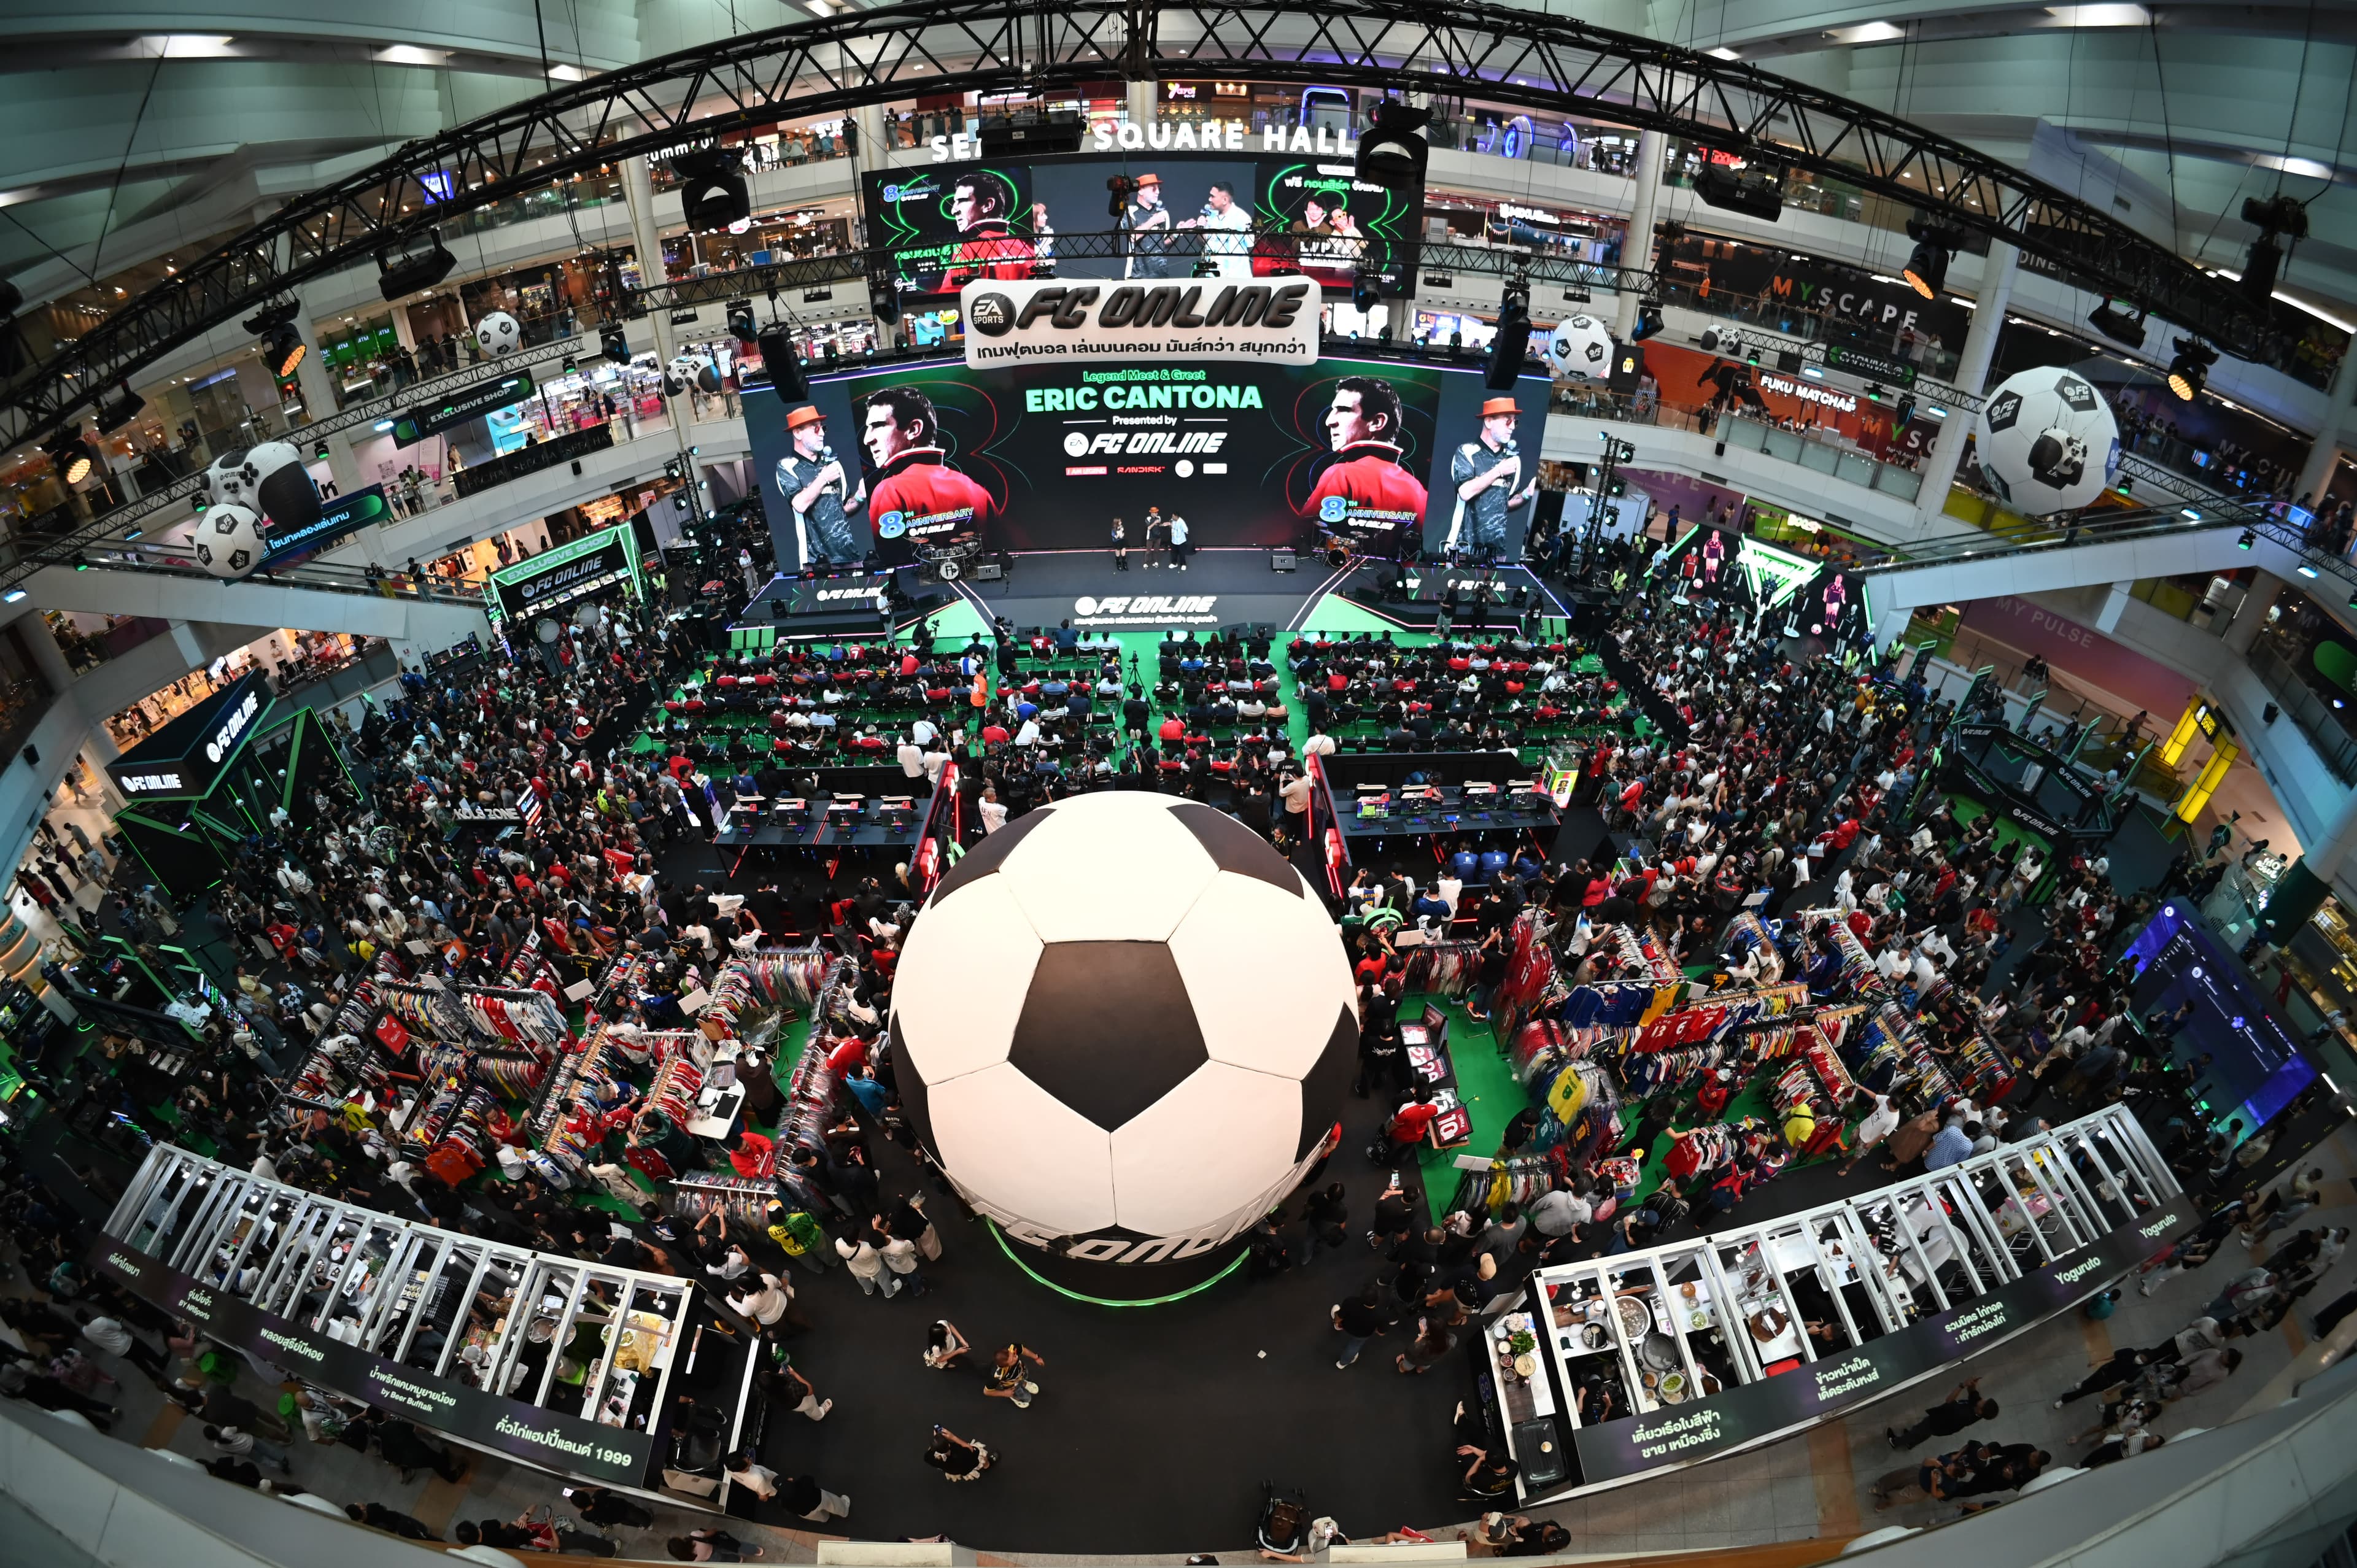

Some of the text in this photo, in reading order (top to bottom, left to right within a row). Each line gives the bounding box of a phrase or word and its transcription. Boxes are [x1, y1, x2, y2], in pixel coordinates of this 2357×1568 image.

[931, 122, 1355, 162] SE SQUARE HALL
[883, 185, 899, 202] 8
[973, 299, 1003, 316] EA
[1016, 284, 1309, 330] FC ONLINE
[973, 315, 1004, 325] SPORTS
[977, 337, 1306, 359] เกมฟุตบอล เล่นบนคอม มันส์กว่า สนุกกว่า
[1083, 370, 1206, 384] Legend Meet & Greet
[1026, 385, 1263, 412] ERIC CANTONA
[1760, 376, 1847, 411] FUKU MATCHA
[2075, 385, 2089, 395] FC
[430, 387, 511, 423] EXCLUSIVE SHOP
[2000, 399, 2018, 412] FC
[1113, 415, 1177, 426] Presented by
[1992, 411, 2011, 423] ONLINE
[1088, 432, 1228, 454] FC ONLINE
[906, 507, 974, 528] ANNIVERSARY
[1320, 496, 1347, 522] 8
[1346, 509, 1417, 520] ANNIVERSARY
[269, 511, 350, 550] โซนทดลองเล่นเกม
[878, 511, 906, 538] 8
[507, 535, 608, 581] EXCLUSIVE SHOP
[535, 555, 603, 593] FC ONLINE
[827, 589, 844, 600] FC
[1095, 596, 1217, 614] FC ONLINE
[1995, 596, 2094, 649] MY PULSE
[217, 690, 258, 754] FC ONLINE
[133, 773, 182, 791] FC ONLINE
[2062, 772, 2092, 798] FC ONLINE
[452, 807, 521, 820] KOLS ZONE
[2019, 812, 2059, 835] FC ONLINE
[581, 965, 589, 978] 7
[1651, 1024, 1667, 1038] 13
[1676, 1021, 1687, 1034] 6
[1700, 1016, 1714, 1029] 7
[1562, 1084, 1573, 1100] 8
[1438, 1113, 1458, 1141] 10
[1540, 1122, 1549, 1137] 8
[2138, 1214, 2177, 1238] Yoguruto
[2054, 1256, 2102, 1285] Yoguruto
[179, 1299, 187, 1308] BY
[1945, 1301, 2003, 1332] รวมมิตร ไก่ทอด
[1815, 1357, 1871, 1385] ข้าวหน้าเป็ด
[370, 1365, 457, 1406] น้ำพริกแคบหมูยายน้อย
[1817, 1367, 1879, 1401] เด็ดระดับหงส์
[381, 1388, 434, 1412] by Beer Bufftalk
[1631, 1409, 1720, 1443] เตี๋ยวเรือใบสีฟ้า
[495, 1414, 632, 1467] คั่วไก่แฮปปี้แลนด์ 1999
[1641, 1424, 1721, 1458] ชาย เหมืองซิ่ง
